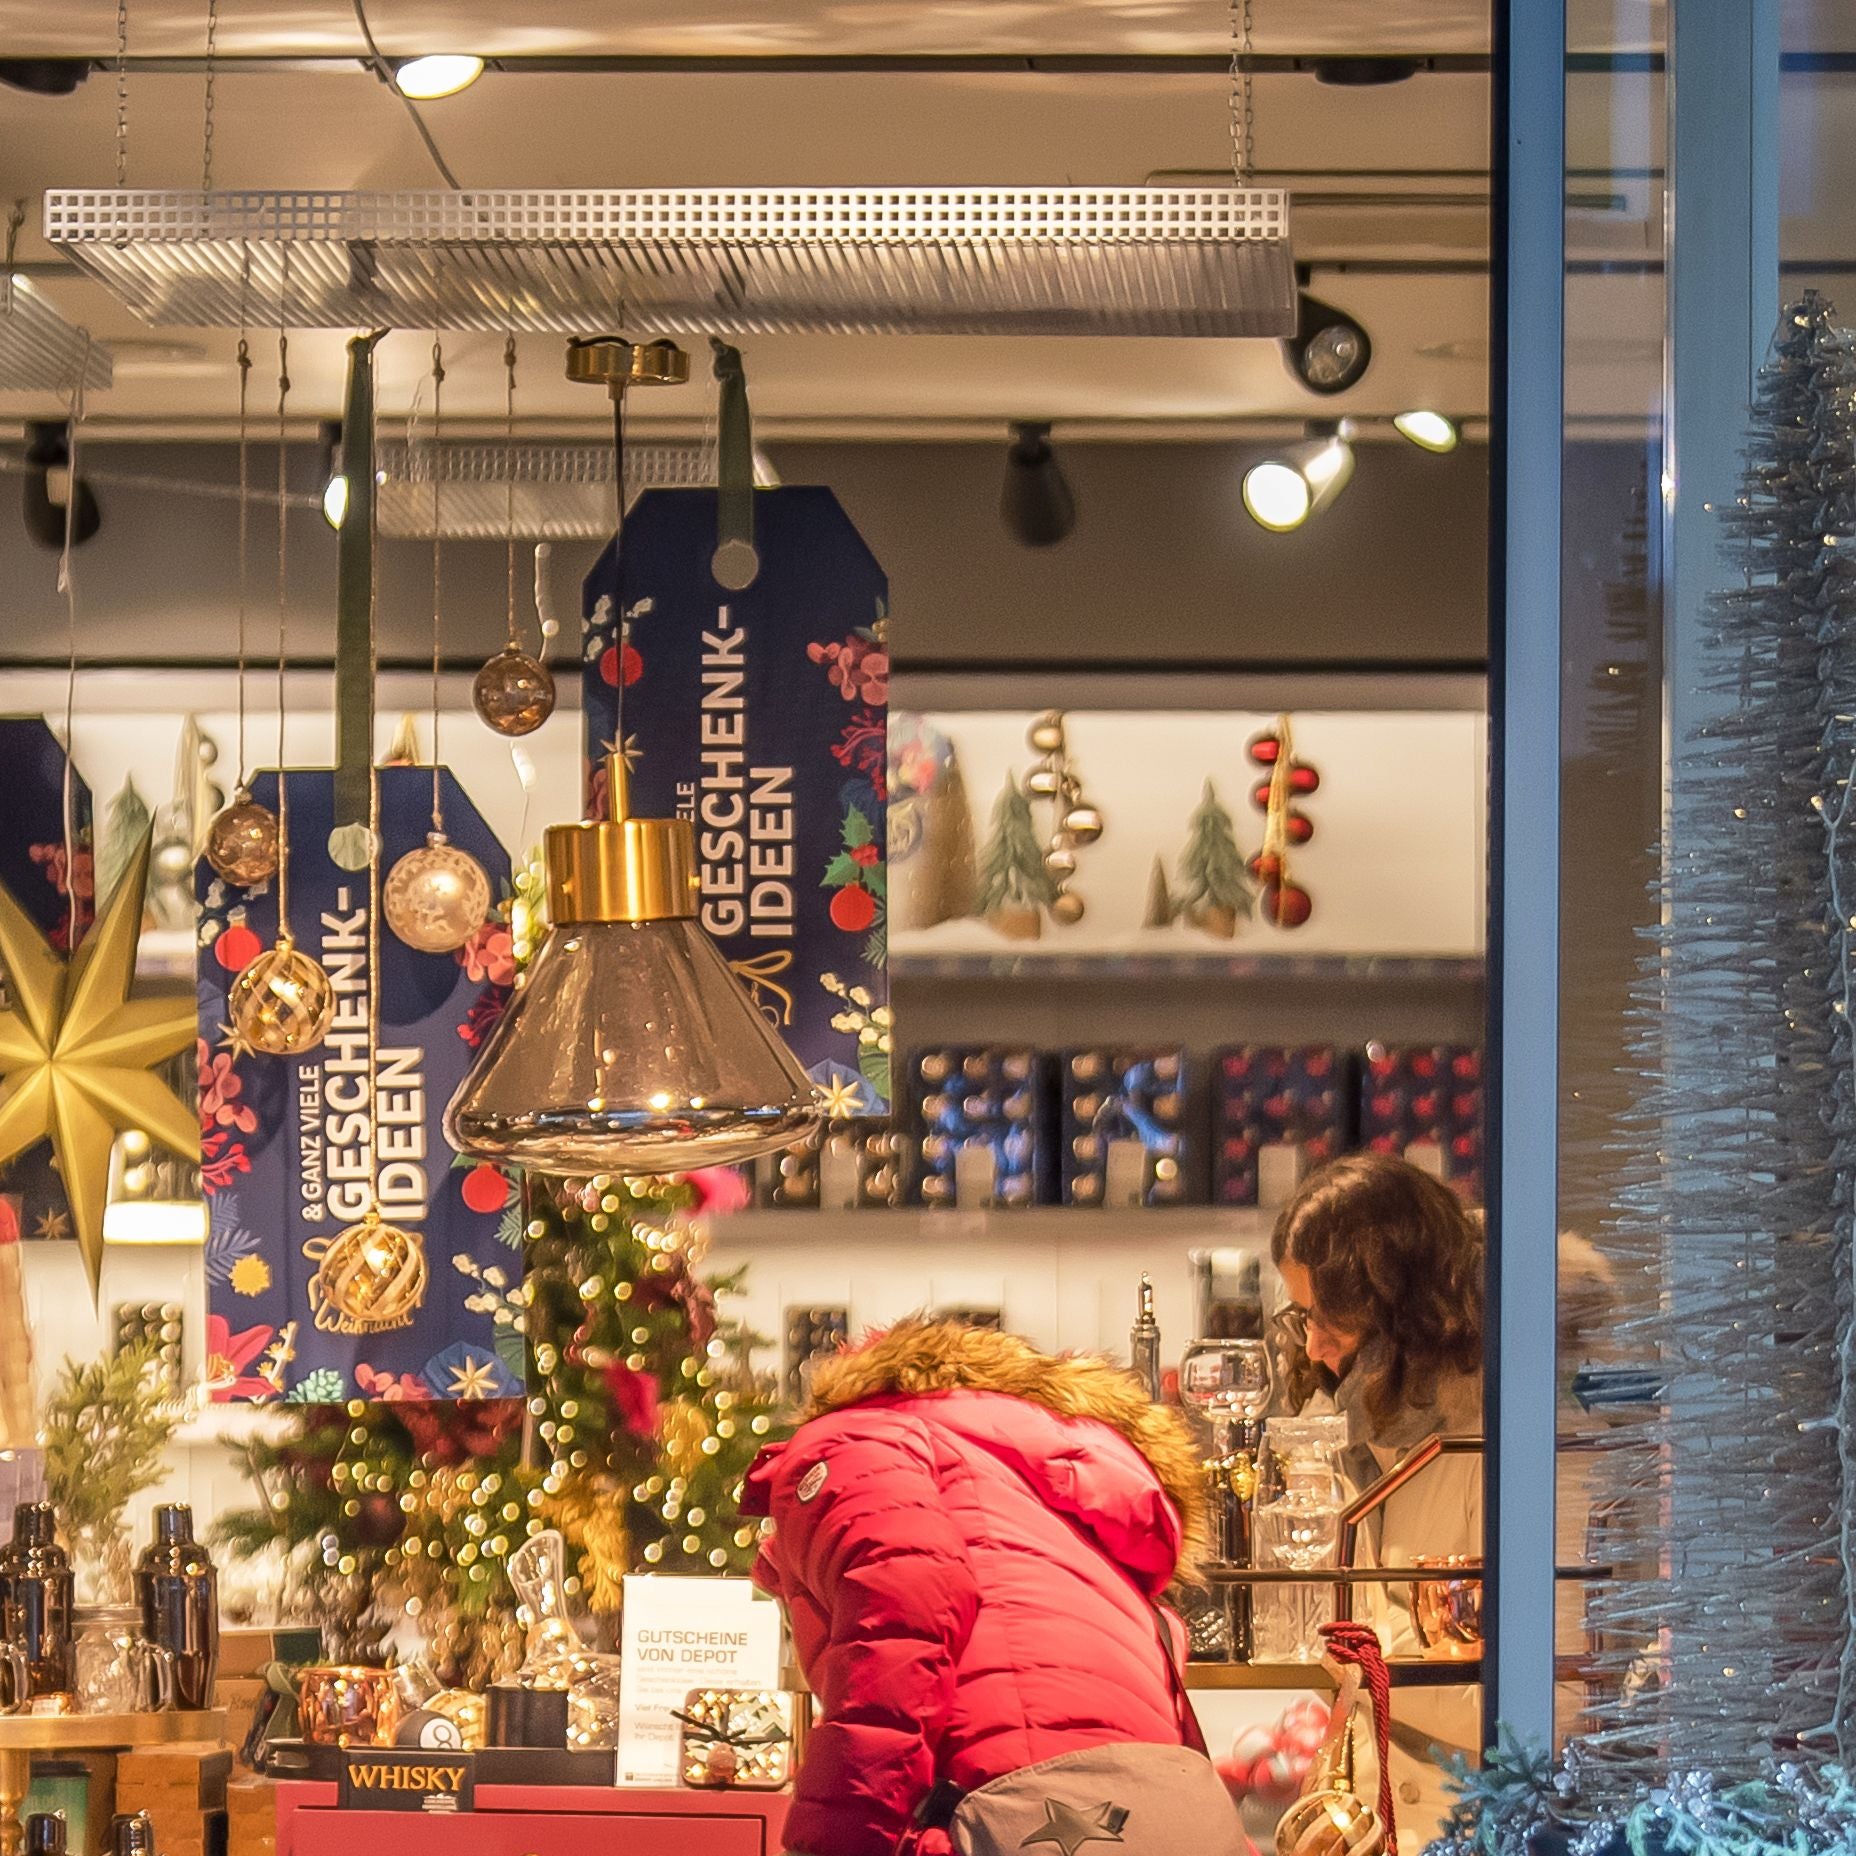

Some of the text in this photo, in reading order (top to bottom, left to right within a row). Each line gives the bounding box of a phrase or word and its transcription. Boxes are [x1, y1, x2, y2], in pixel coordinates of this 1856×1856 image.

[701, 605, 745, 937] GESCHENK-
[749, 766, 796, 937] IDEEN
[321, 887, 372, 1221] GESCHENK-
[375, 1047, 428, 1221] IDEEN
[299, 1065, 325, 1222] & GANZ VIELE
[638, 1629, 748, 1646] GUTSCHEINE
[638, 1647, 738, 1664] VON DEPOT
[348, 1764, 466, 1792] WHISKY
